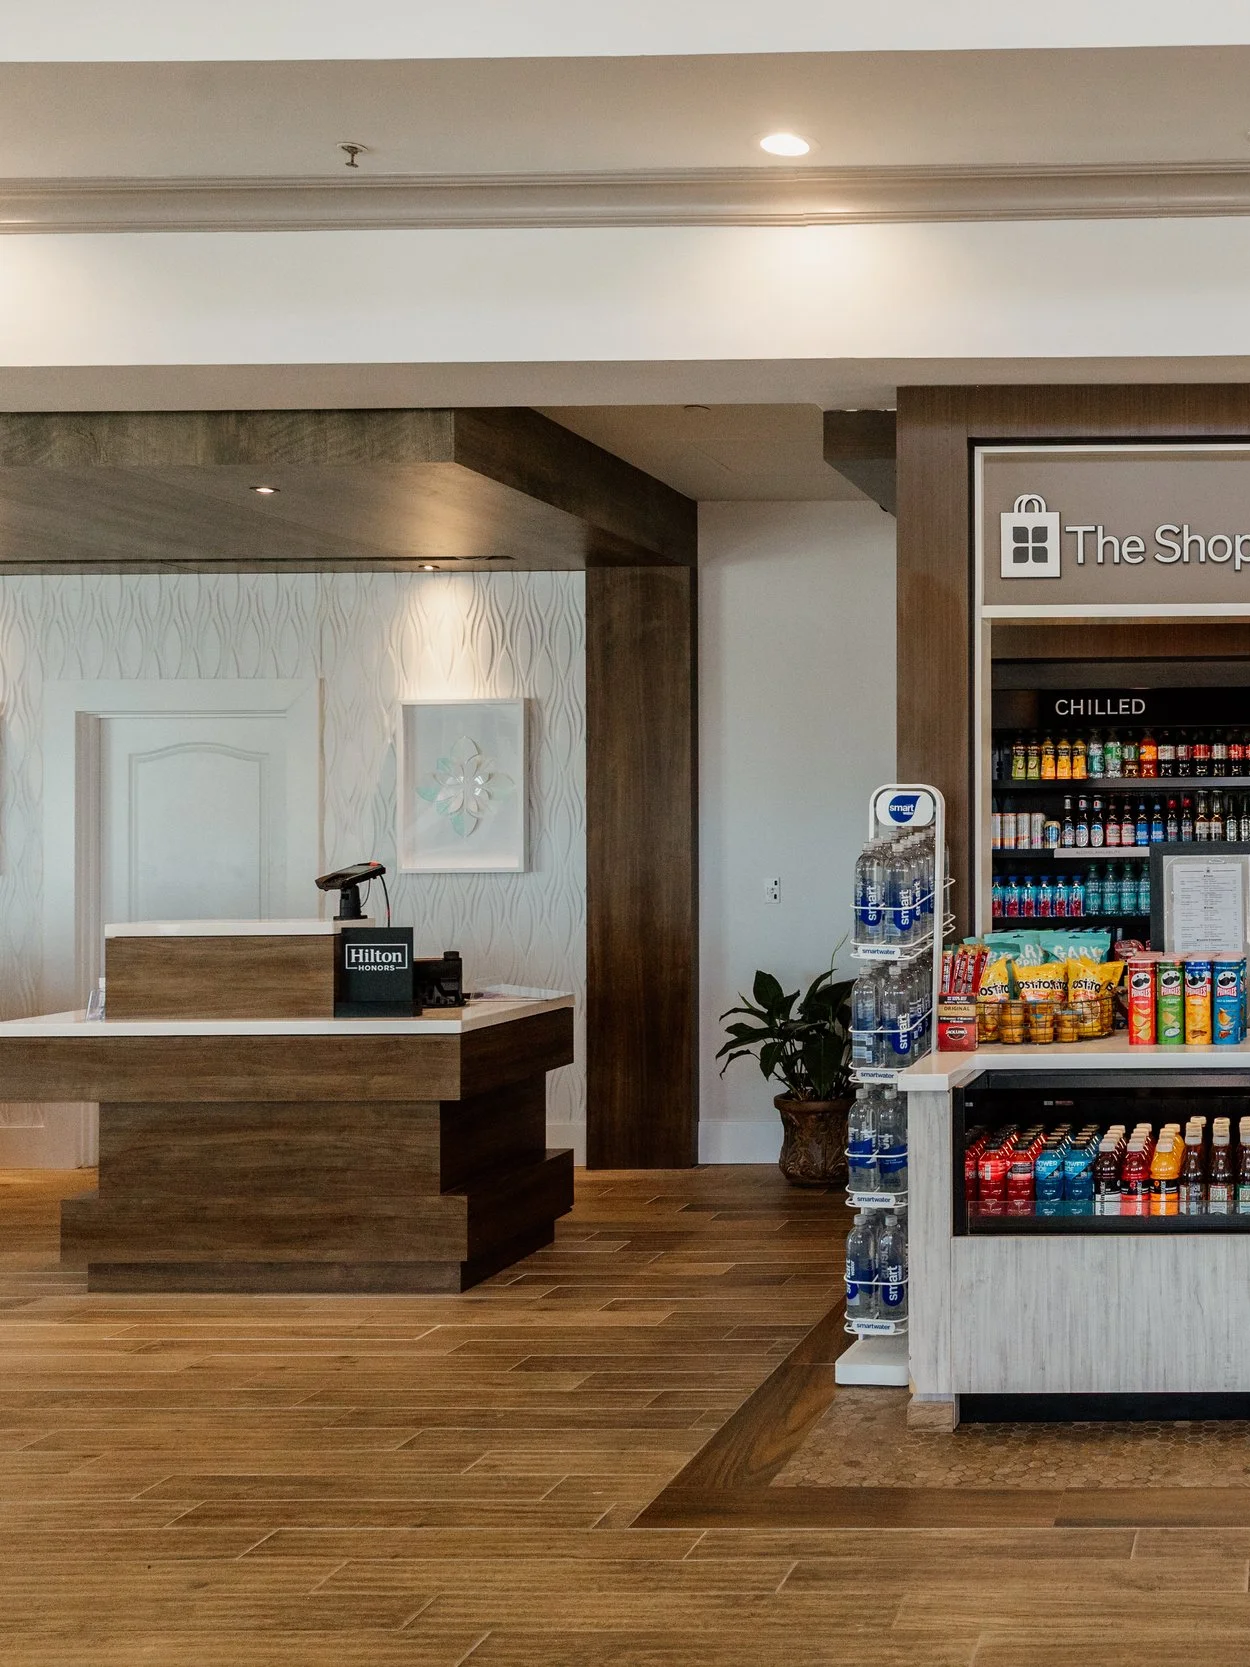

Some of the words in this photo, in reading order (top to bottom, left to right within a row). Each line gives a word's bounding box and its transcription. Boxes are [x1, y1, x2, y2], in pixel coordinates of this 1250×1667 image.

[1065, 525, 1146, 564] The
[1055, 699, 1146, 716] CHILLED
[889, 804, 915, 812] smart
[867, 886, 877, 921] smart
[899, 889, 909, 925] smart
[351, 948, 402, 963] Hilton
[897, 1013, 908, 1050] smart
[887, 1265, 898, 1301] smart
